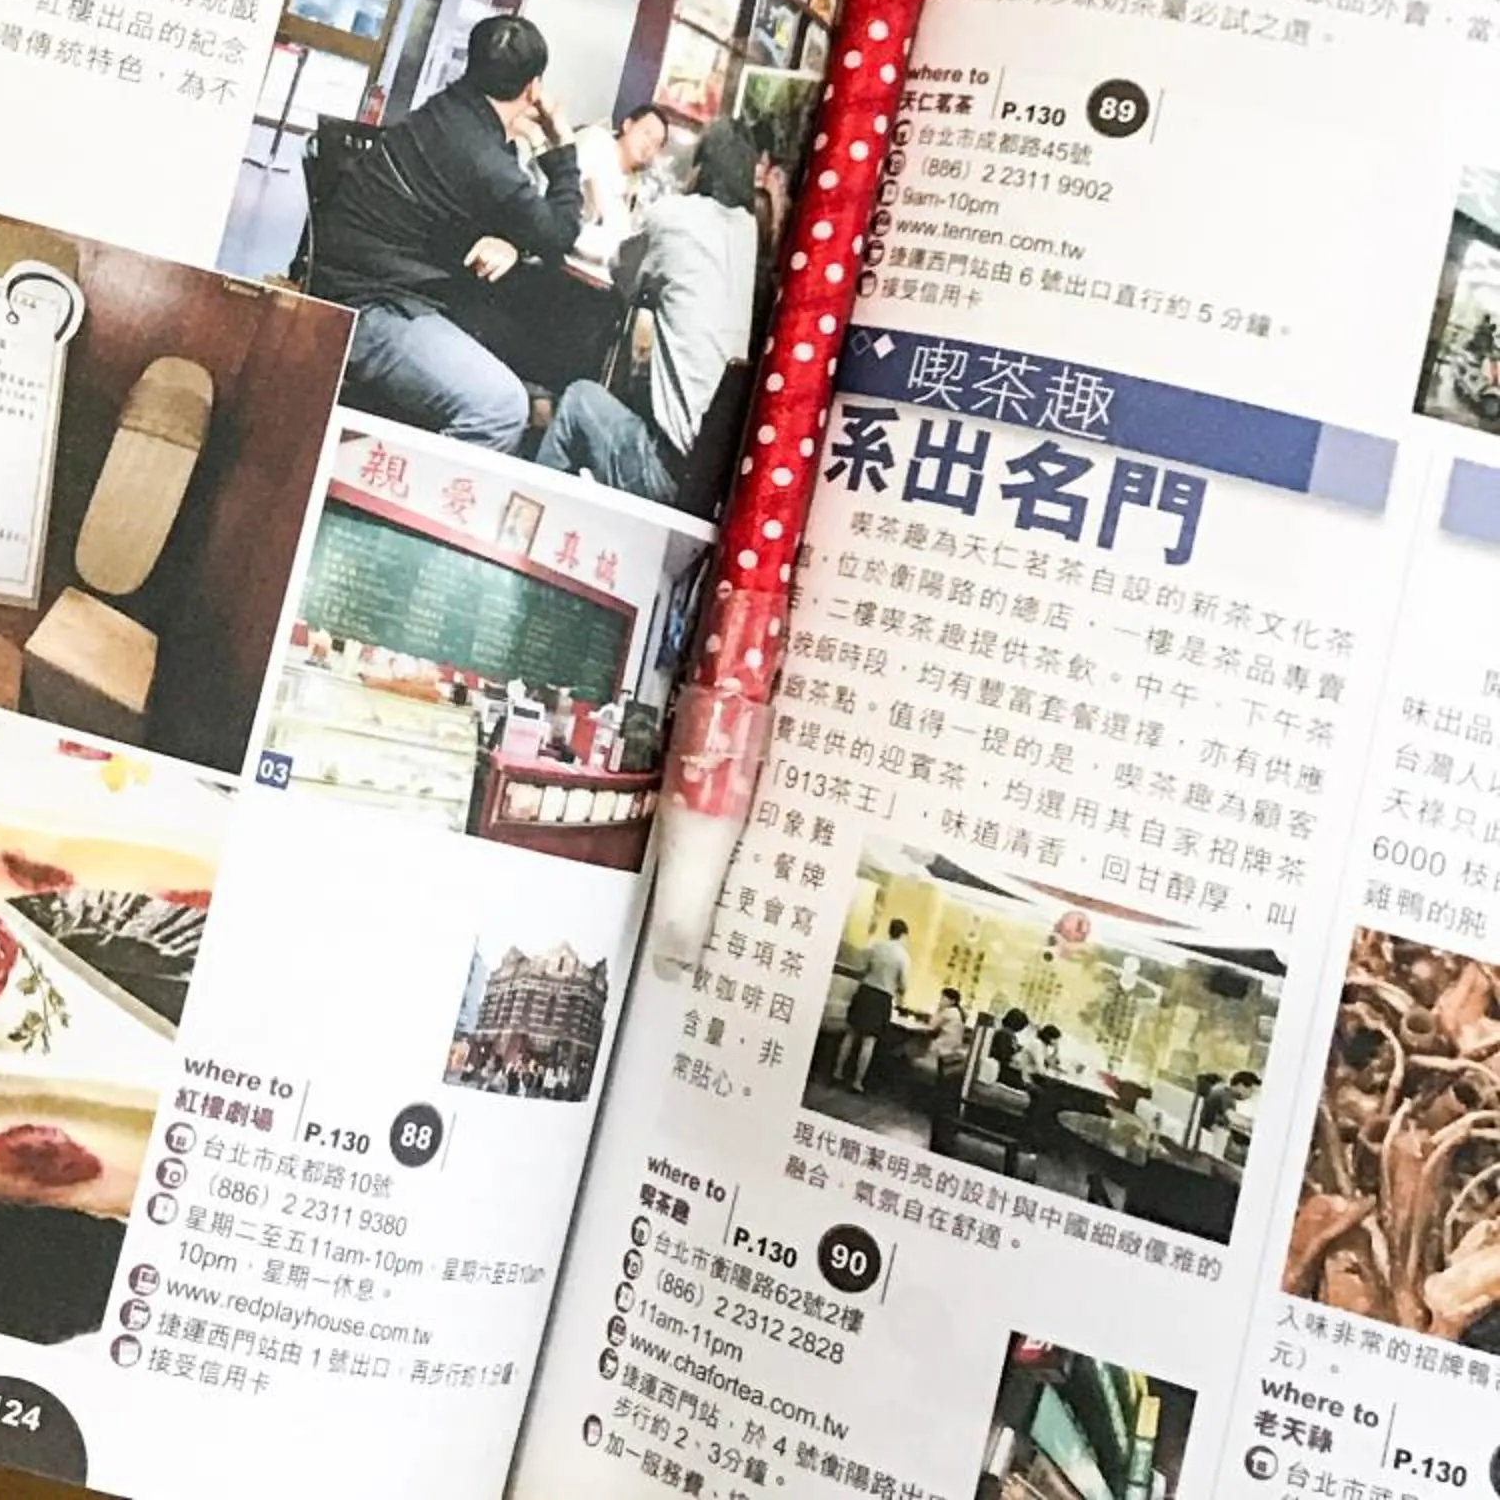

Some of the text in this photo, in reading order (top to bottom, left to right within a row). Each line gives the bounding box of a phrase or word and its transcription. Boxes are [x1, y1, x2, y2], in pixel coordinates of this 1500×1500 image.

[907, 64, 990, 86] where to
[1001, 101, 1067, 128] P.130
[1099, 96, 1137, 124] 89
[901, 186, 1000, 217] 9am-10pm
[981, 164, 1114, 202] 2 2311 9902
[894, 216, 1087, 262] www.tenren.com.tw
[906, 341, 1117, 442] 喫茶趣
[823, 403, 1210, 567] 系出名門
[261, 760, 288, 784] 03
[756, 800, 838, 849] 印象難
[1372, 835, 1447, 878] 6000
[183, 1056, 295, 1100] where to
[303, 1121, 372, 1156] P.130
[399, 1121, 433, 1151] 88
[646, 1155, 728, 1203] where to
[281, 1192, 408, 1238] 2 2311 9380
[733, 1224, 800, 1270] P.130
[829, 1244, 868, 1278] 90
[165, 1278, 435, 1347] www.redplayhouse.com.tw
[637, 1299, 744, 1363] 11am-11pm
[713, 1295, 846, 1365] 2 2312 2828
[1276, 1304, 1500, 1393] 入味非常的招牌鴨
[628, 1332, 850, 1442] www.chafortea.com.tw
[1260, 1377, 1380, 1429] where to
[1393, 1447, 1469, 1488] P.130
